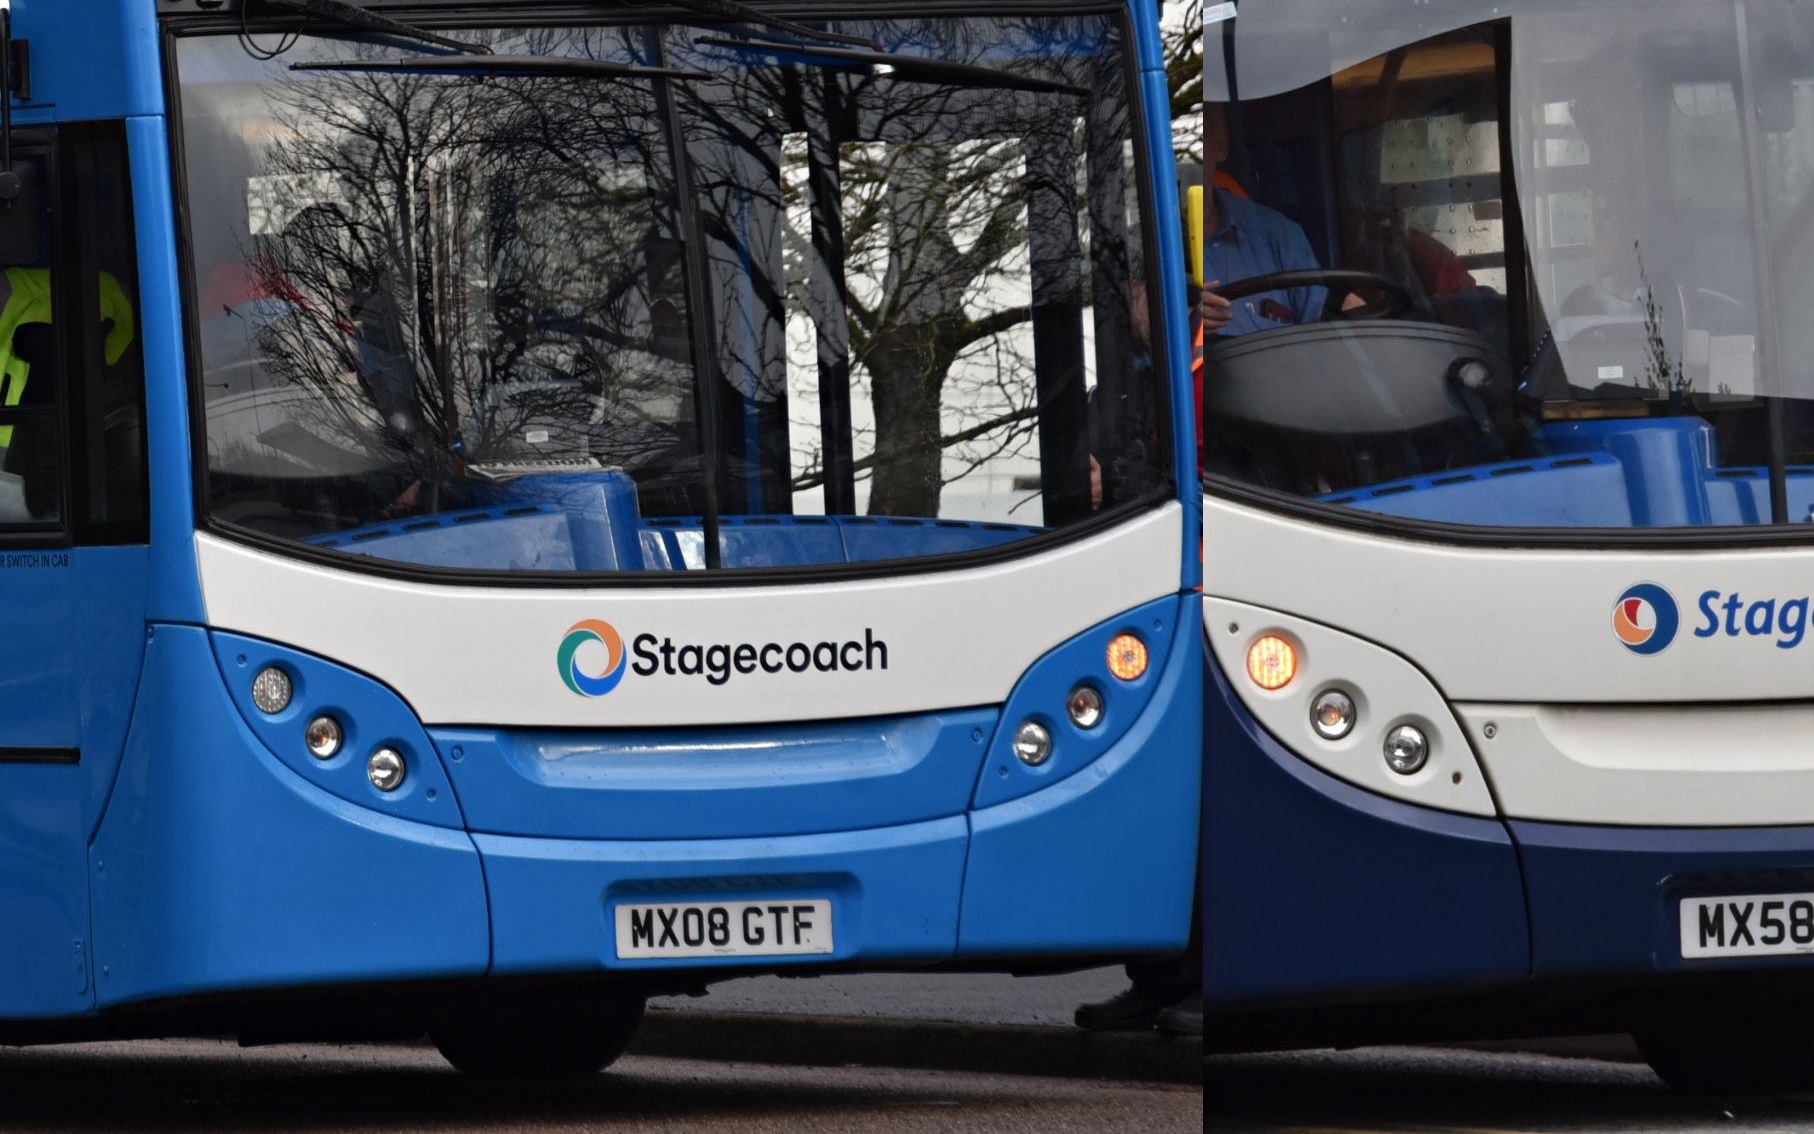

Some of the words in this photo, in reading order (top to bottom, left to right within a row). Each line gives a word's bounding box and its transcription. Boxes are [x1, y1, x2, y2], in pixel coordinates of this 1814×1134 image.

[7, 554, 39, 568] SWITCH
[41, 554, 50, 568] IN
[52, 553, 69, 567] CAB
[631, 627, 889, 686] Stagecoach
[631, 906, 731, 948] MX08
[742, 904, 815, 946] GTF
[1698, 900, 1814, 948] MX58
